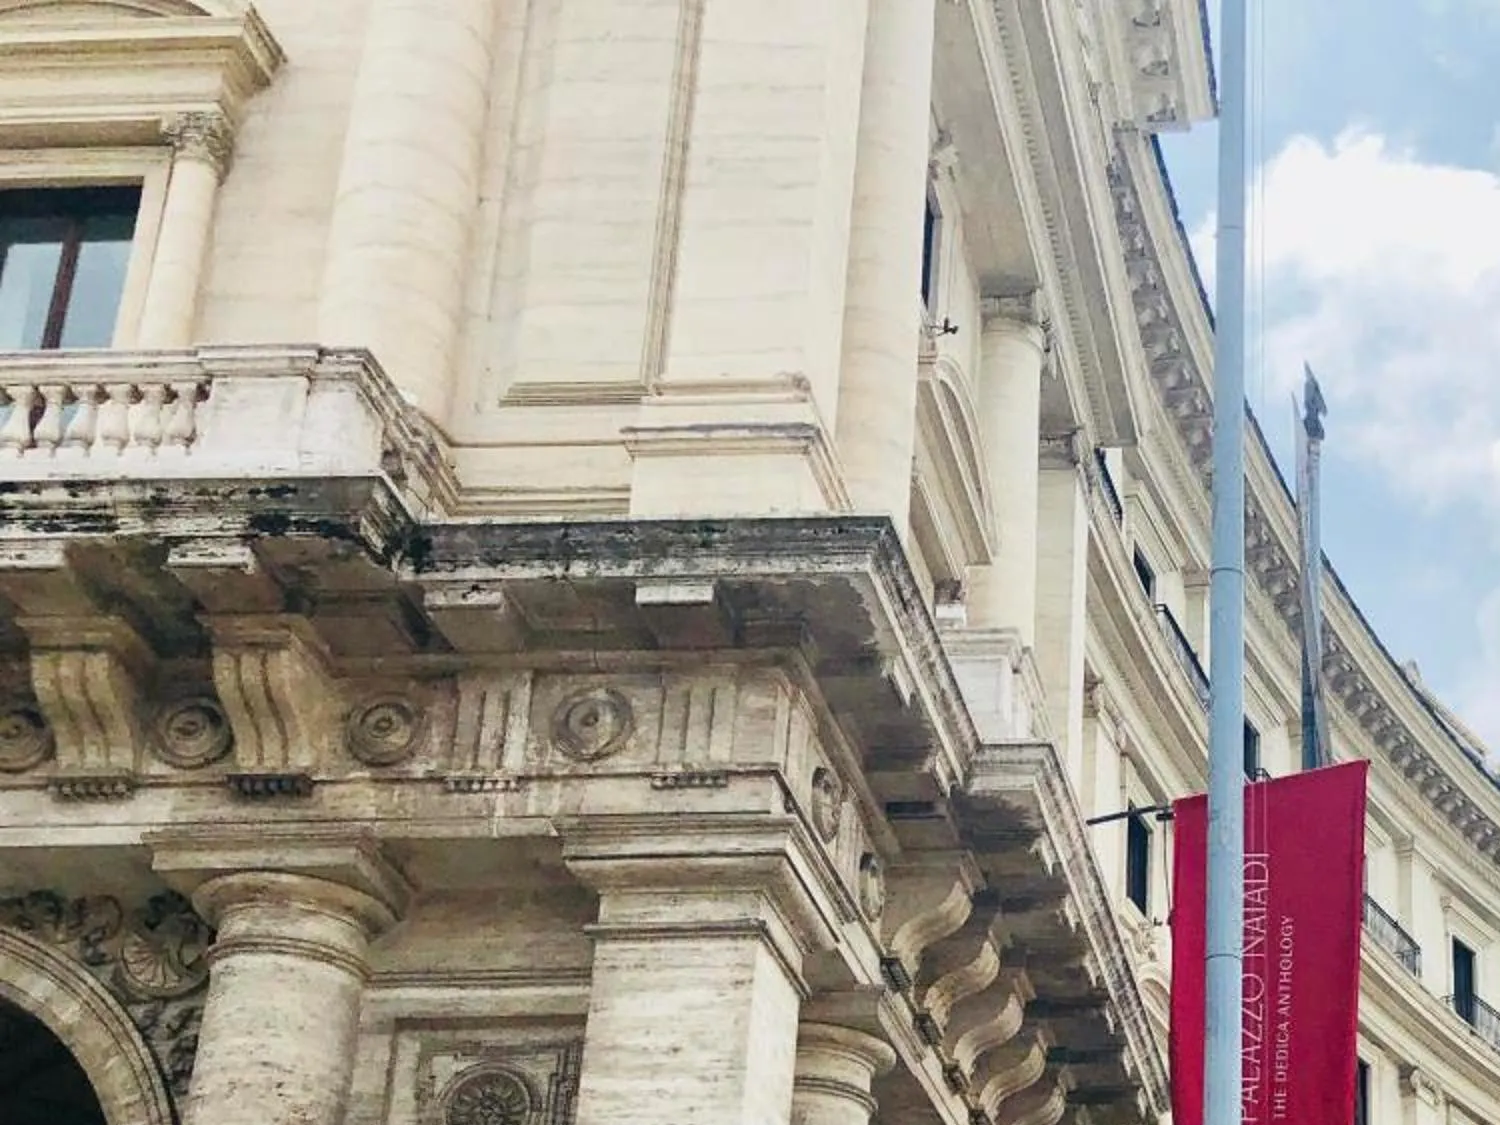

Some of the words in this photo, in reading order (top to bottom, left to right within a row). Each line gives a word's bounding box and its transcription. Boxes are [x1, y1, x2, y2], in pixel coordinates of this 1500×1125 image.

[1241, 853, 1270, 958] NAIADI
[1277, 915, 1295, 1017] ANTHOLOGY
[1275, 1021, 1290, 1082] DEDICA
[1273, 1088, 1287, 1119] THE
